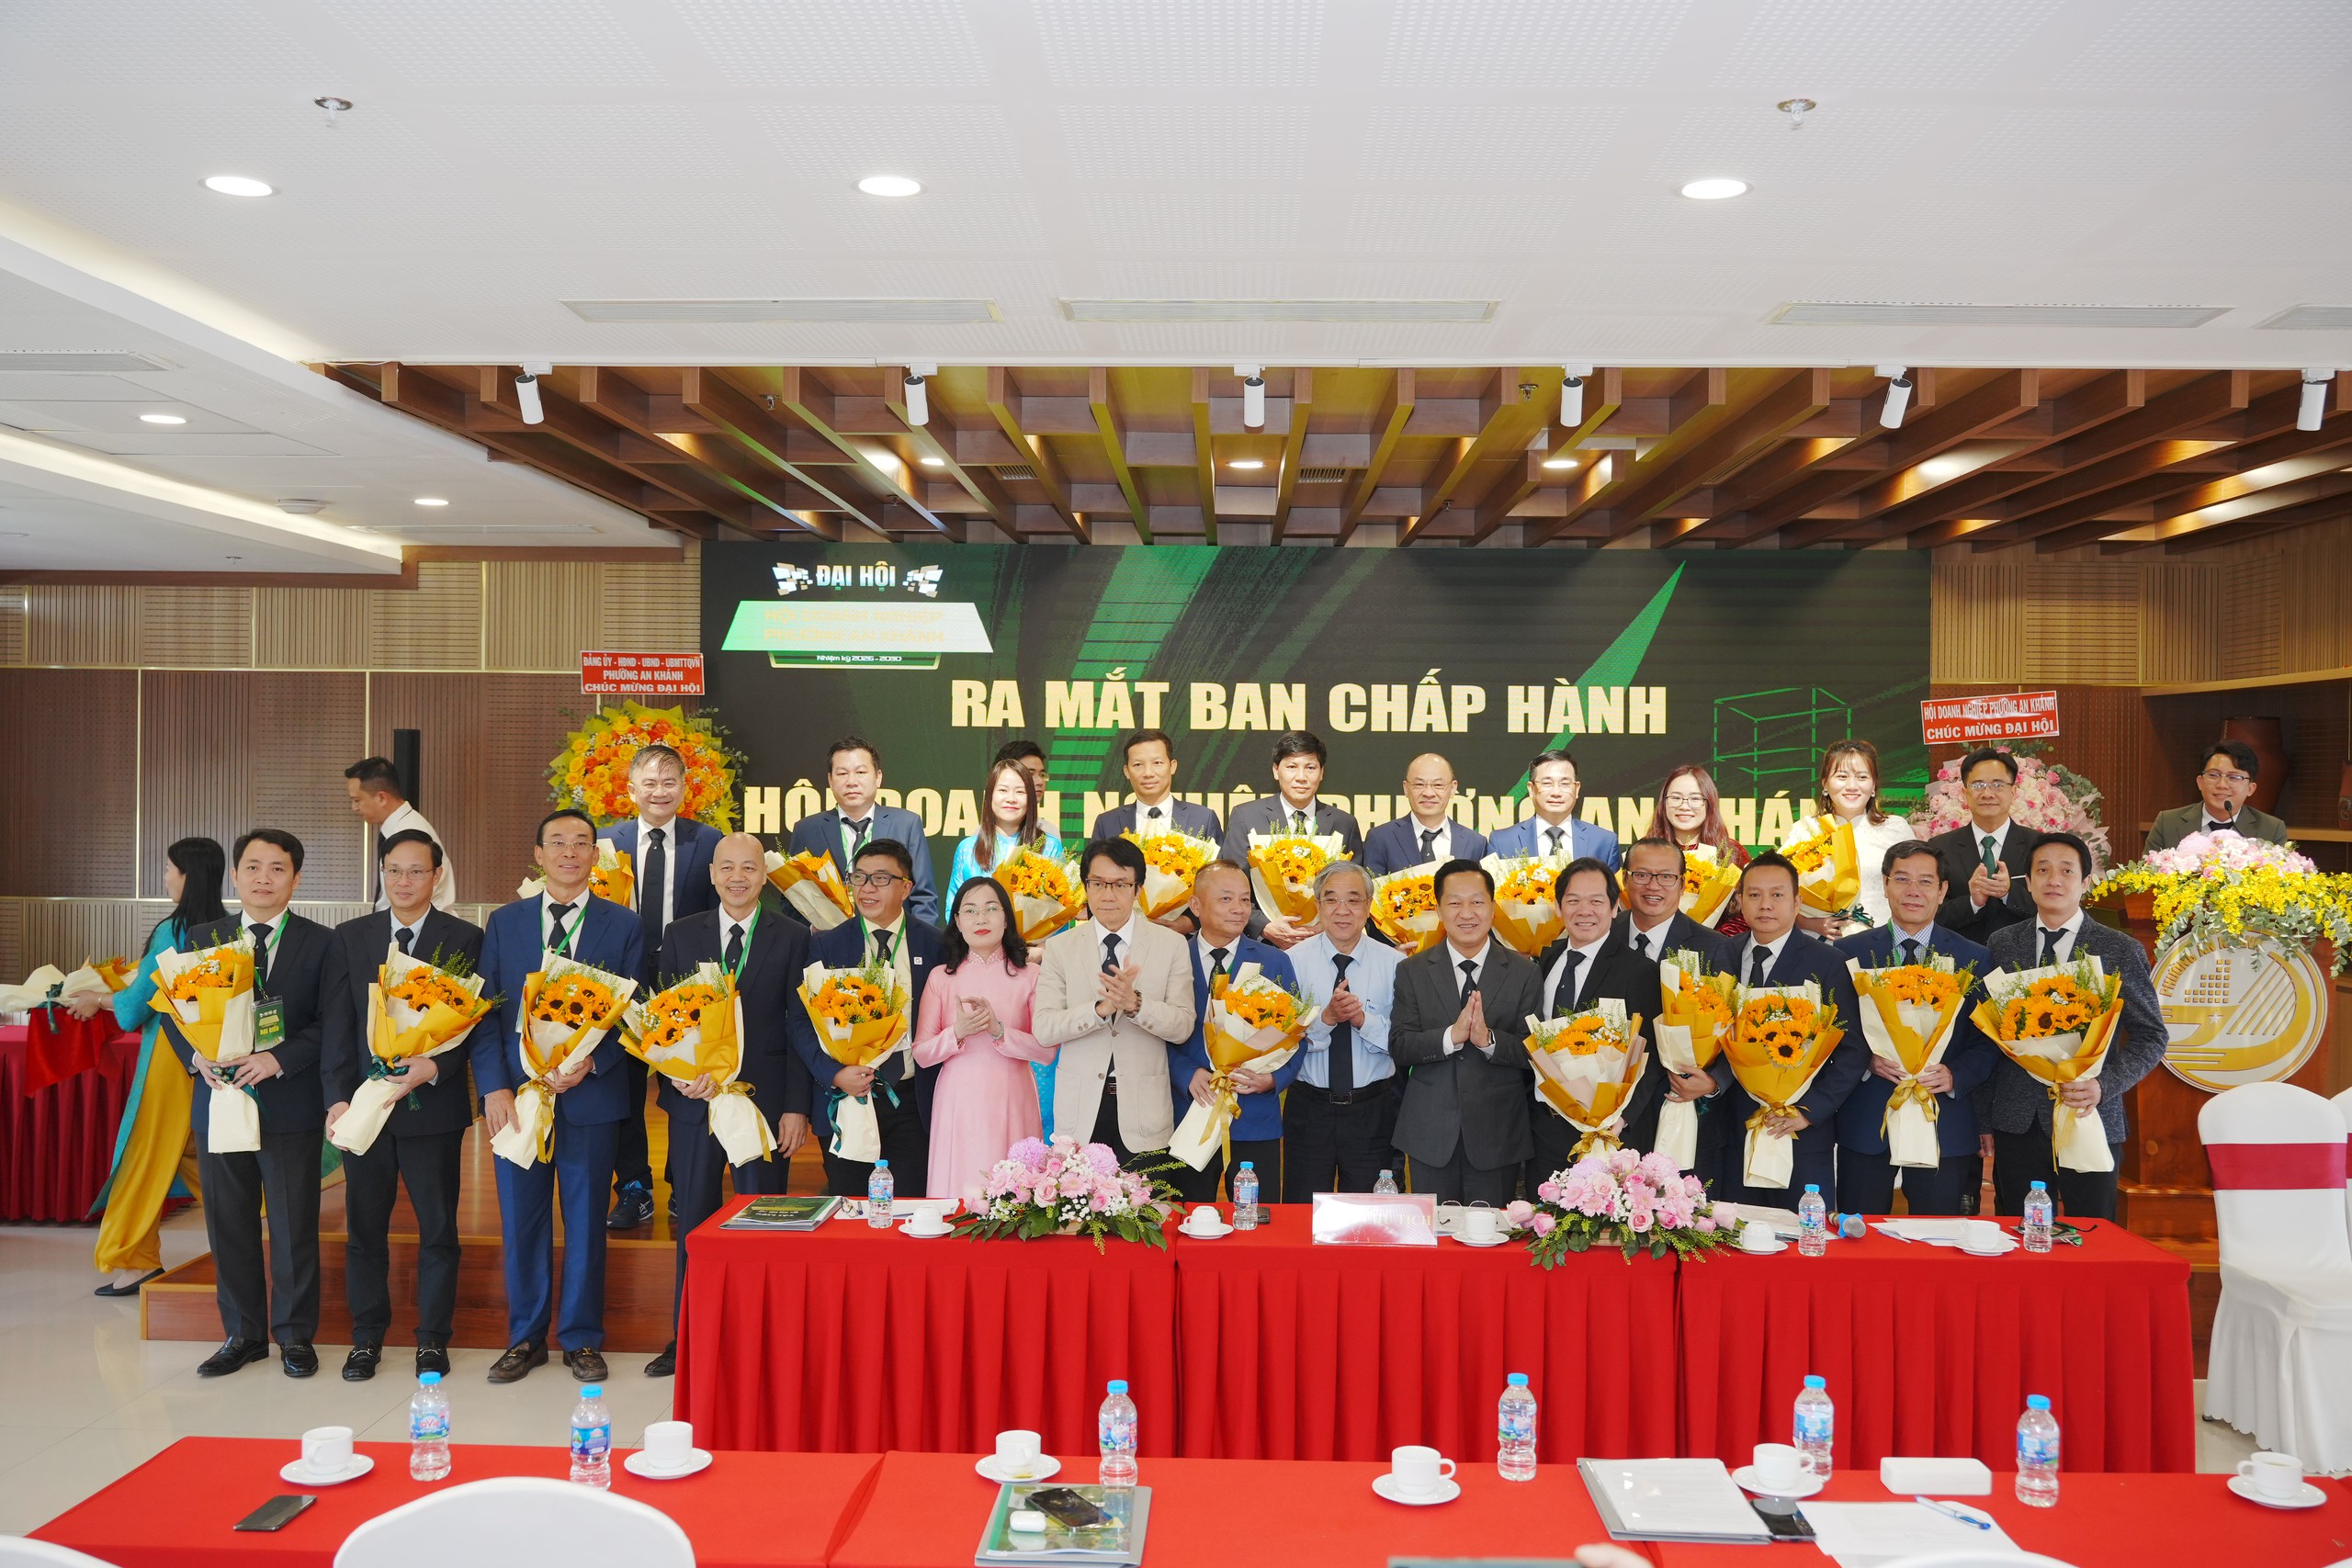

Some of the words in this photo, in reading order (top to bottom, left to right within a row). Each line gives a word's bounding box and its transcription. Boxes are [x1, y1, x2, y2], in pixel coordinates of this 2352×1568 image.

[816, 565, 852, 591] ĐẠI
[860, 560, 896, 592] HỘI
[583, 653, 602, 666] ĐẢNG
[603, 654, 612, 667] ỦY
[642, 658, 660, 667] UBND
[603, 668, 638, 680] PHƯỜNG
[640, 671, 651, 680] AN
[654, 669, 684, 681] KHÁNH
[584, 682, 616, 692] CHÚC
[620, 682, 654, 692] MỪNG
[657, 684, 677, 694] ĐẠI
[681, 682, 700, 694] HỘI
[952, 680, 1024, 728] RA
[1045, 667, 1169, 729] MẮT
[1190, 682, 1306, 730] BAN
[1329, 668, 1486, 733] CHẤP
[1508, 678, 1667, 734] HÀNH
[1924, 703, 1936, 723] HỘI
[1938, 705, 1962, 720] DOANH
[1989, 696, 2018, 715] PHƯỜNG
[2019, 699, 2030, 713] AN
[2030, 694, 2055, 712] KHÁNH
[1927, 725, 1961, 739] CHÚC
[1964, 722, 2002, 737] MỪNG
[2005, 722, 2028, 736] ĐẠI
[2031, 717, 2054, 733] HỘI
